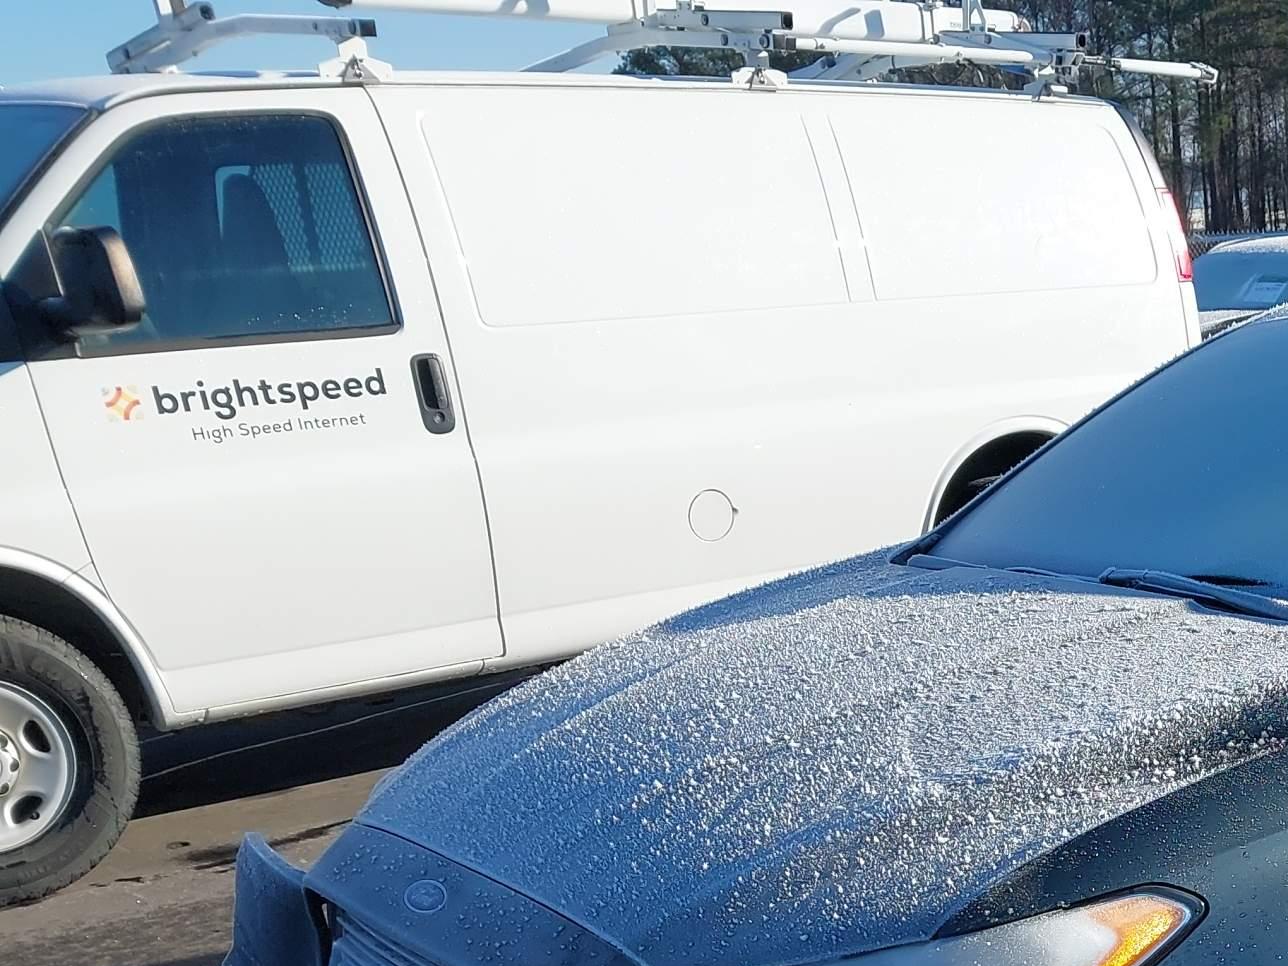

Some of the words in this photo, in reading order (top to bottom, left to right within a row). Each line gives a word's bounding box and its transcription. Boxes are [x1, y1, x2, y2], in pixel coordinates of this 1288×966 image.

[151, 367, 388, 421] brightspeed
[191, 424, 234, 443] High
[238, 418, 293, 439] Speed
[298, 412, 367, 430] Internet
